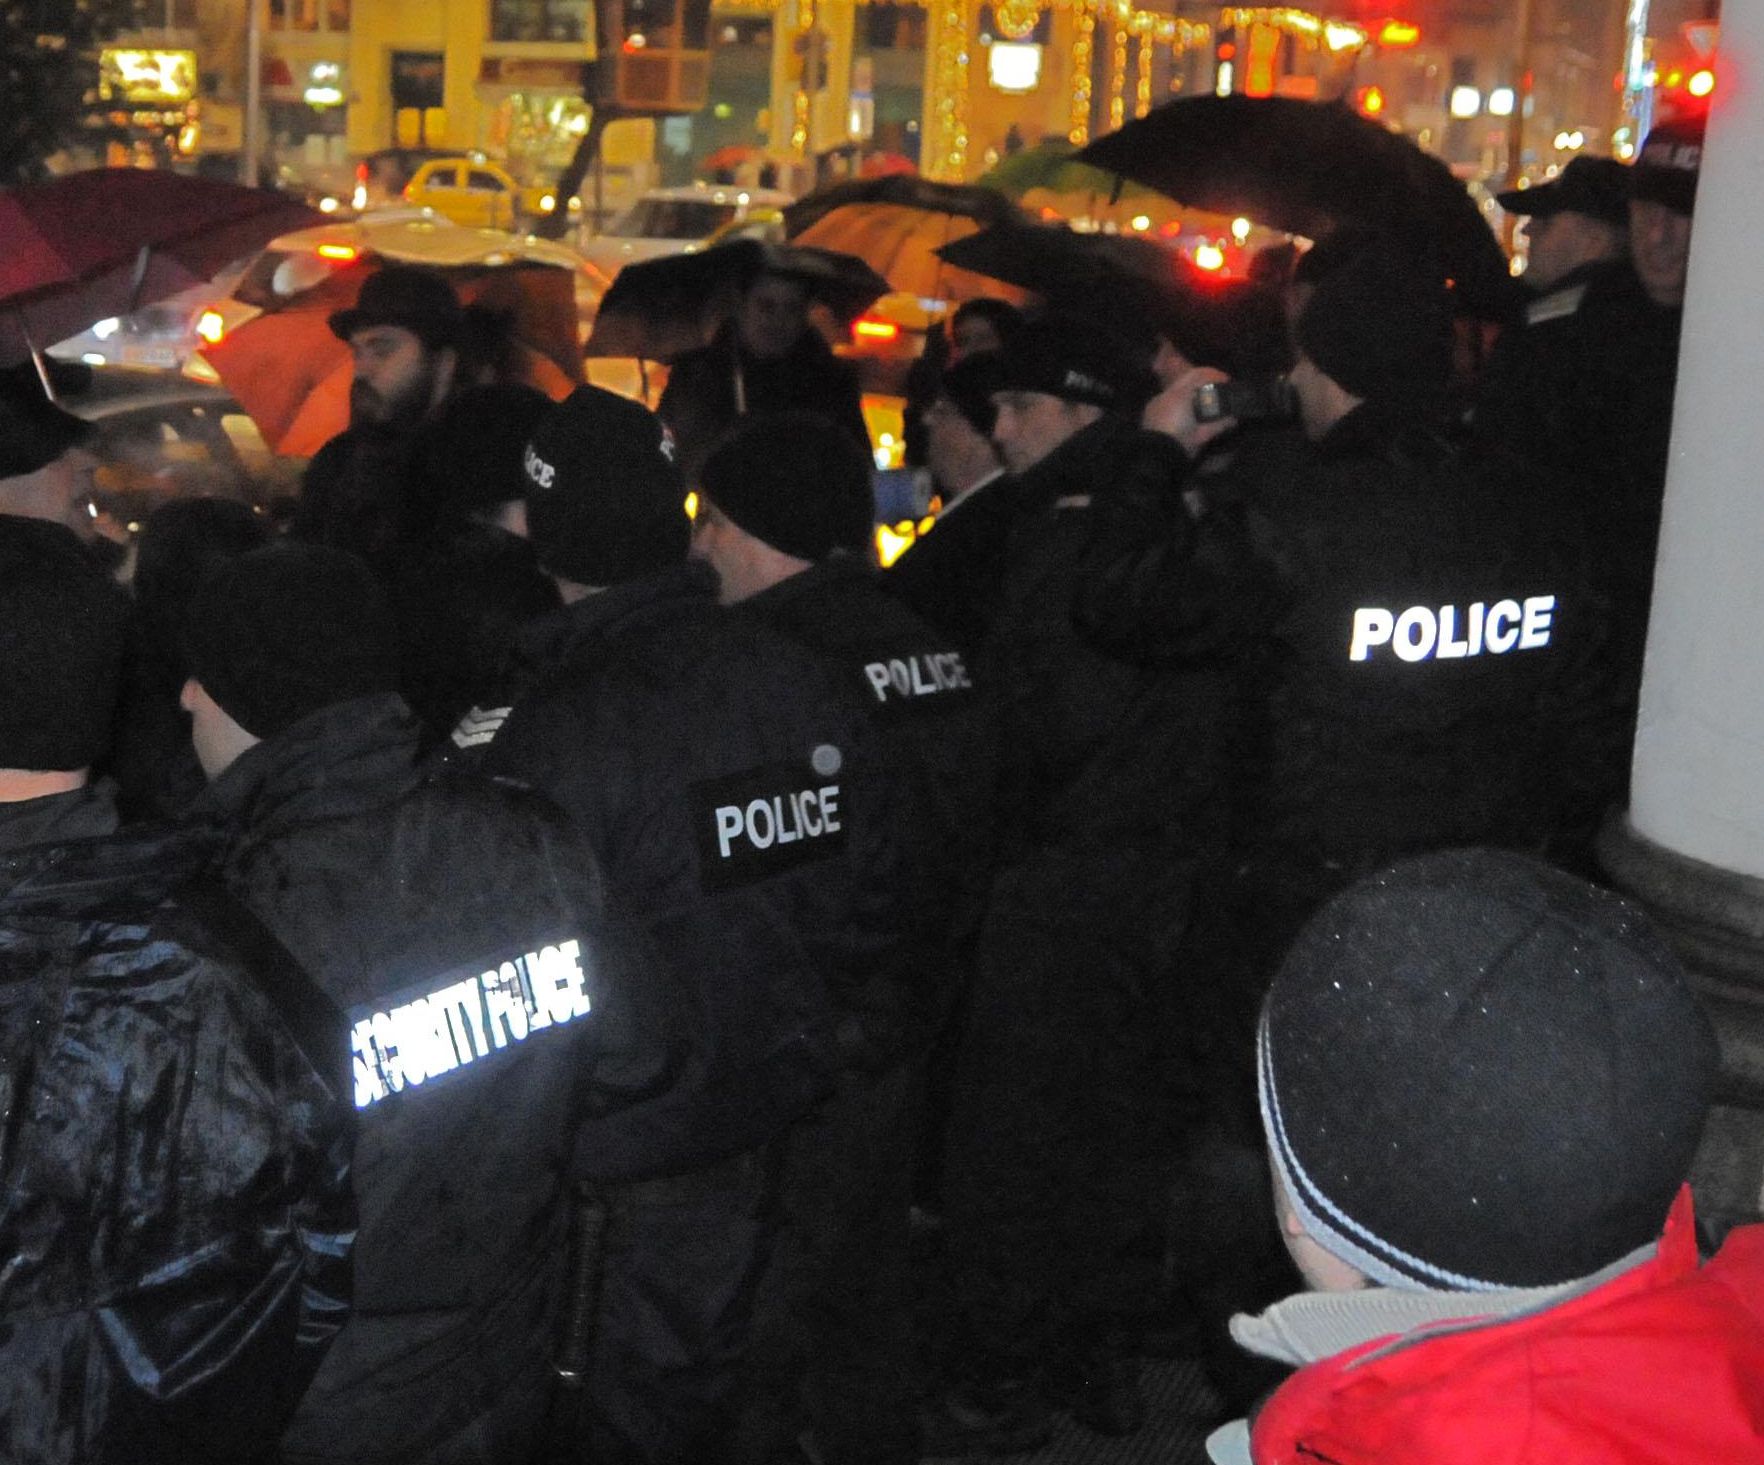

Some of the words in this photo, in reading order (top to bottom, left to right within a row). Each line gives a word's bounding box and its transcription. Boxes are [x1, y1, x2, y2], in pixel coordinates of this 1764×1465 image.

[1349, 595, 1555, 662] POLICE
[864, 652, 972, 702] POLICE
[715, 786, 841, 858] POLICE
[481, 939, 591, 1049] POLICE
